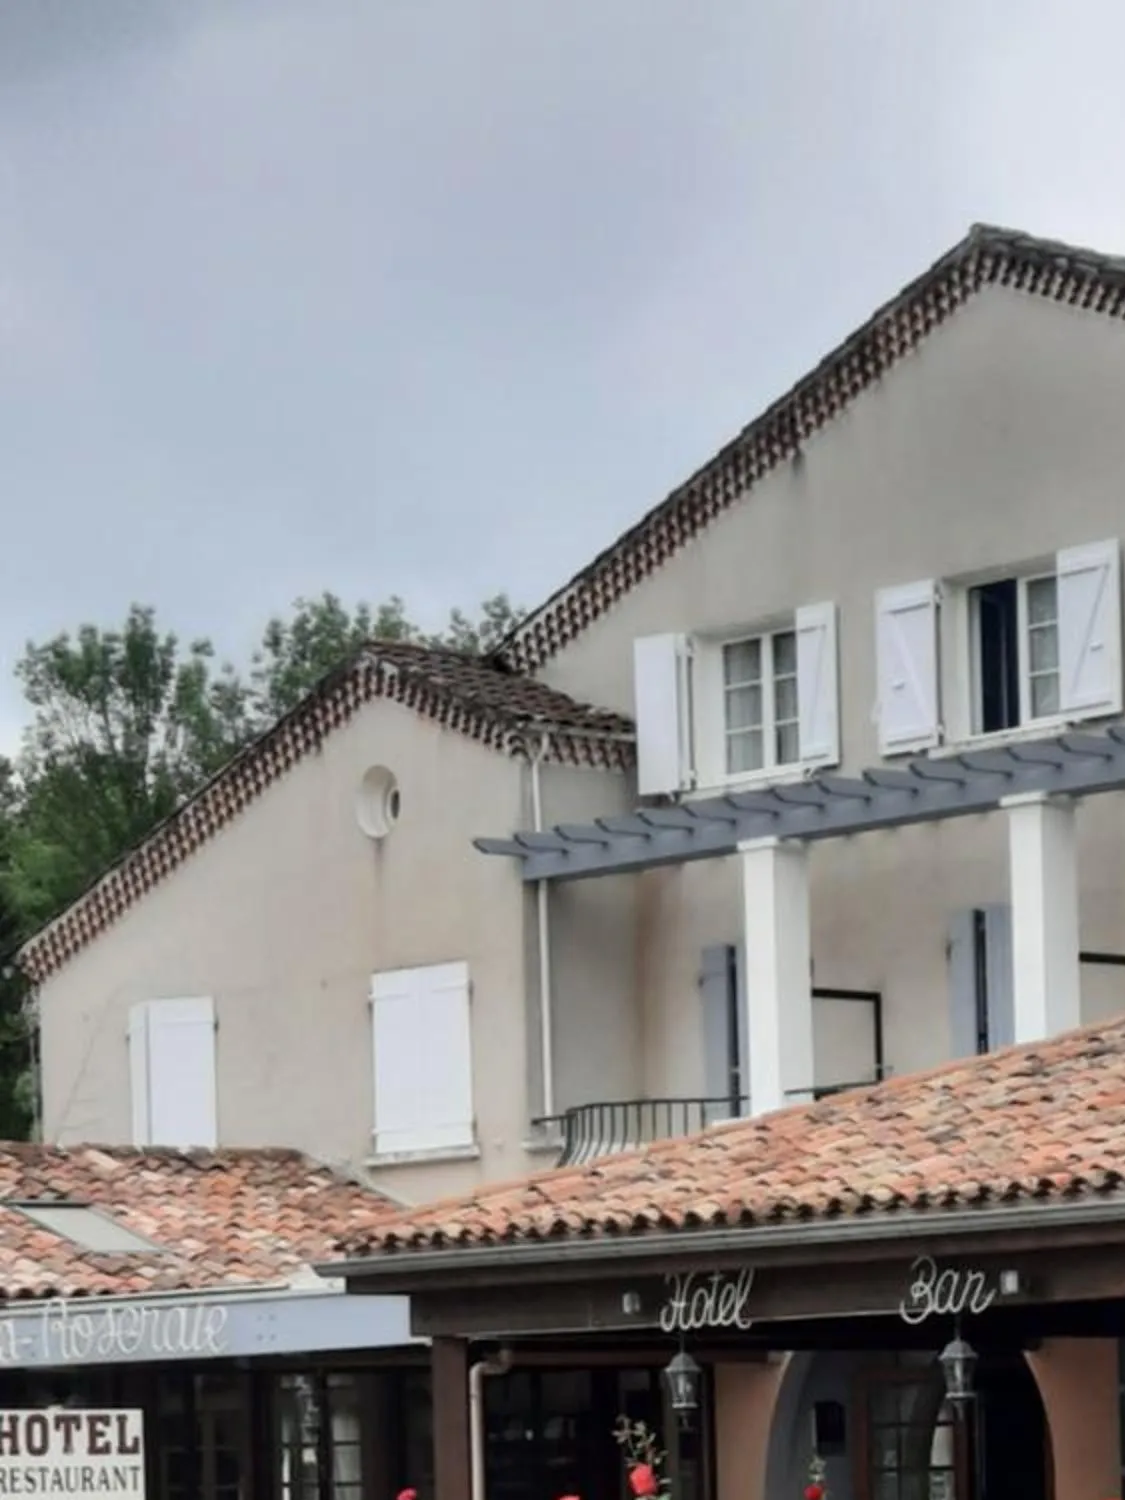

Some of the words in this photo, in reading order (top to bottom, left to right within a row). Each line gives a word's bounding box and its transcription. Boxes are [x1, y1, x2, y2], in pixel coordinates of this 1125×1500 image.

[659, 1266, 754, 1333] Hotel
[900, 1254, 996, 1325] Bar
[0, 1413, 141, 1456] HOTEL
